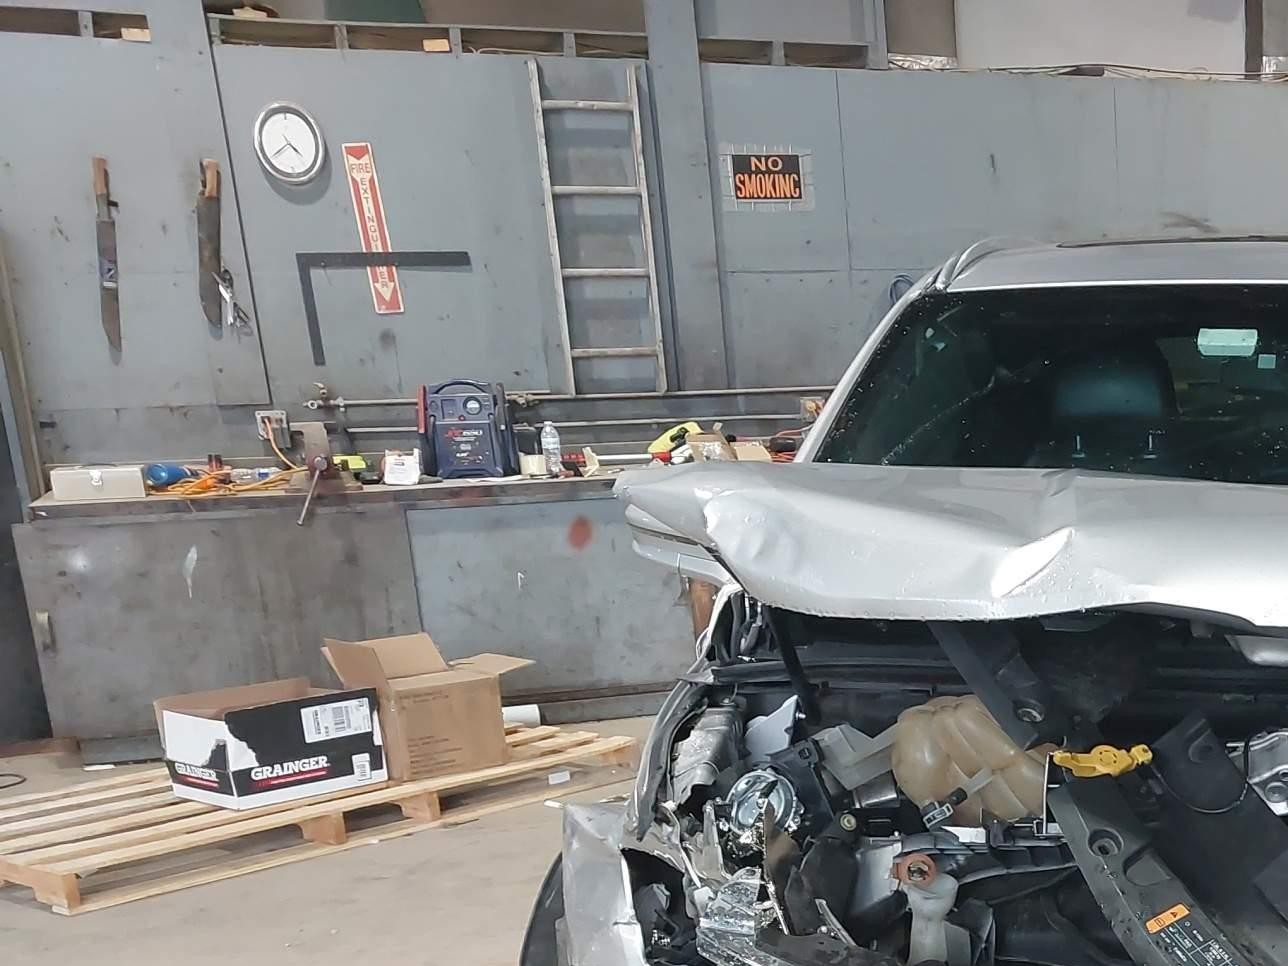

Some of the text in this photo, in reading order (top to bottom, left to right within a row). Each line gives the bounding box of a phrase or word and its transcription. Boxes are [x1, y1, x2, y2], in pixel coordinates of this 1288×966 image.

[350, 162, 371, 174] FIRE
[750, 156, 783, 171] NO
[735, 173, 800, 198] SMOKING
[174, 762, 218, 780] GRAINGER
[250, 755, 330, 781] GRAINGER
